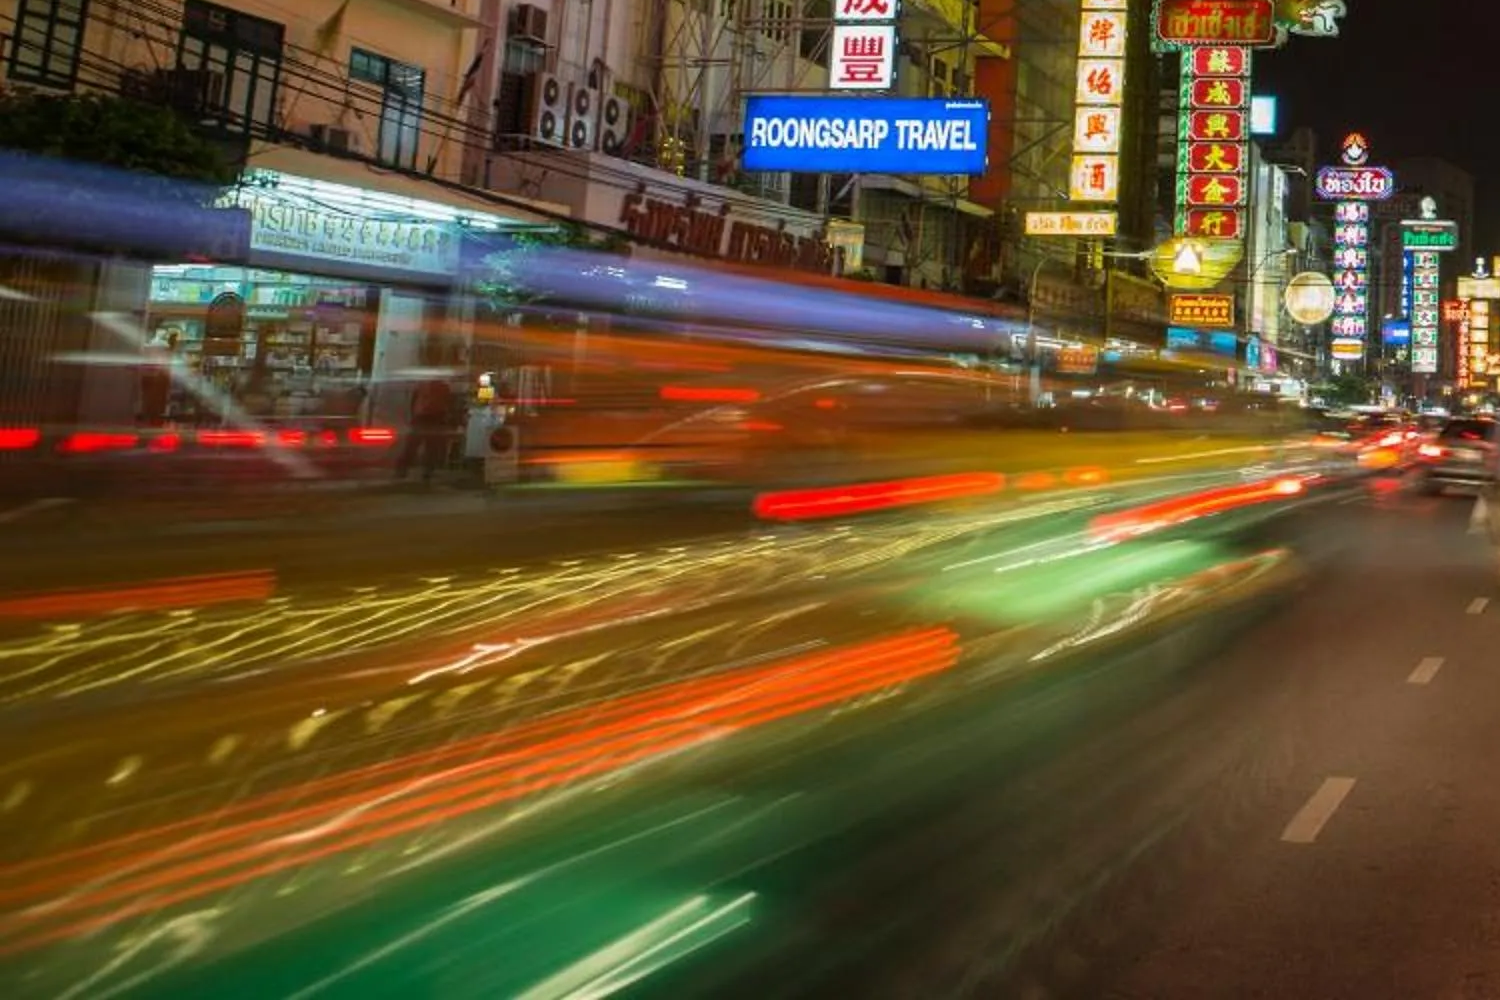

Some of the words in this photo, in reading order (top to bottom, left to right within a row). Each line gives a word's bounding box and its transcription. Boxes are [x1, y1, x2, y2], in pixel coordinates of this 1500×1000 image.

[751, 117, 887, 149] ROONGSARP
[896, 119, 977, 150] TRAVEL
[1325, 171, 1385, 194] ทองใบ
